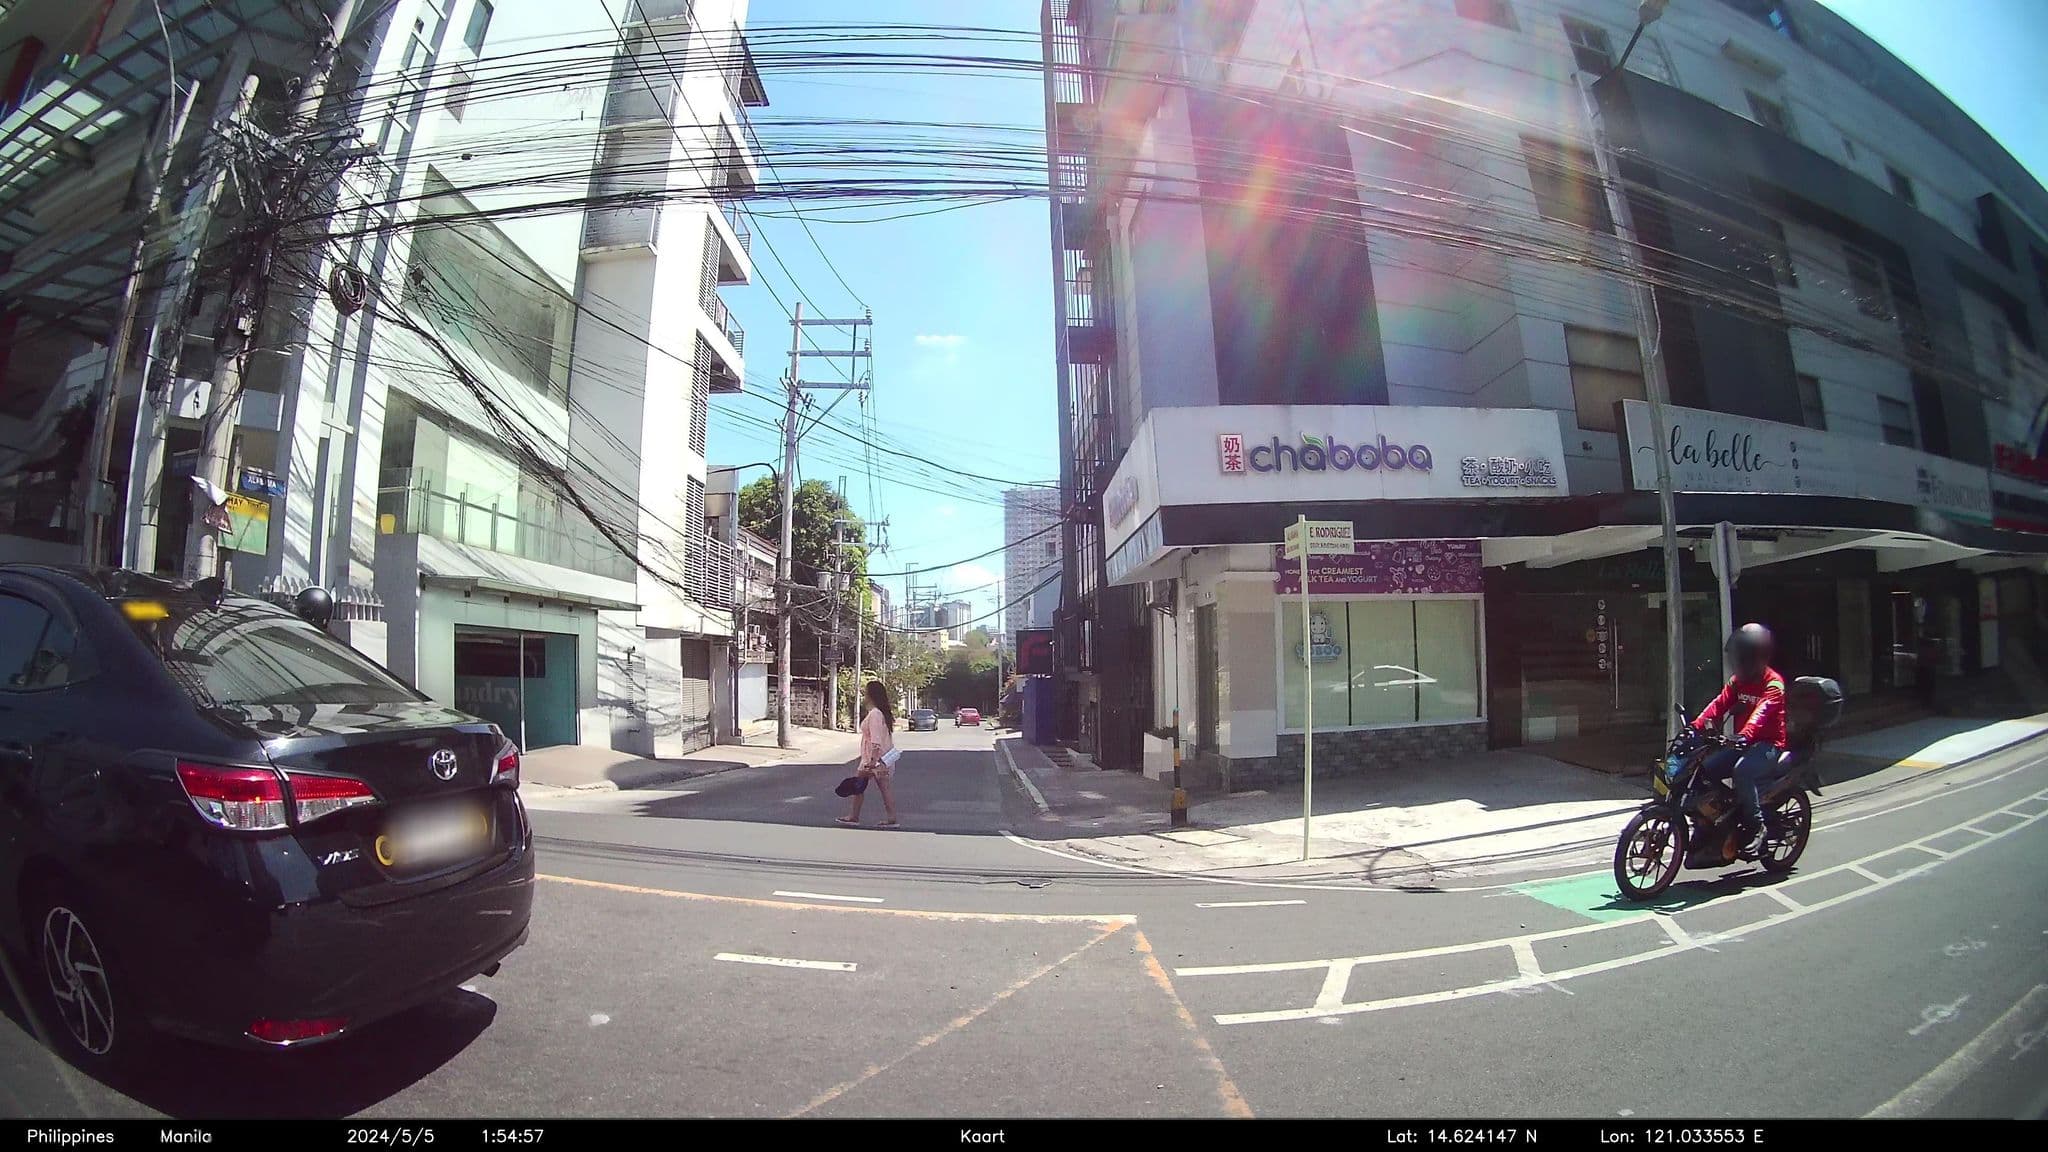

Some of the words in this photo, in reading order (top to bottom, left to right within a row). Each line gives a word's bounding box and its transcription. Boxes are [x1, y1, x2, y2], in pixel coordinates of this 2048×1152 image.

[1223, 436, 1242, 471] 奶茶
[1250, 433, 1433, 473] chaboba
[1463, 477, 1480, 486] TEA
[1488, 477, 1519, 486] YOGURT
[1526, 477, 1557, 486] SNACKS
[1321, 567, 1364, 575] CREAMIEST
[1348, 575, 1378, 583] YOGURT
